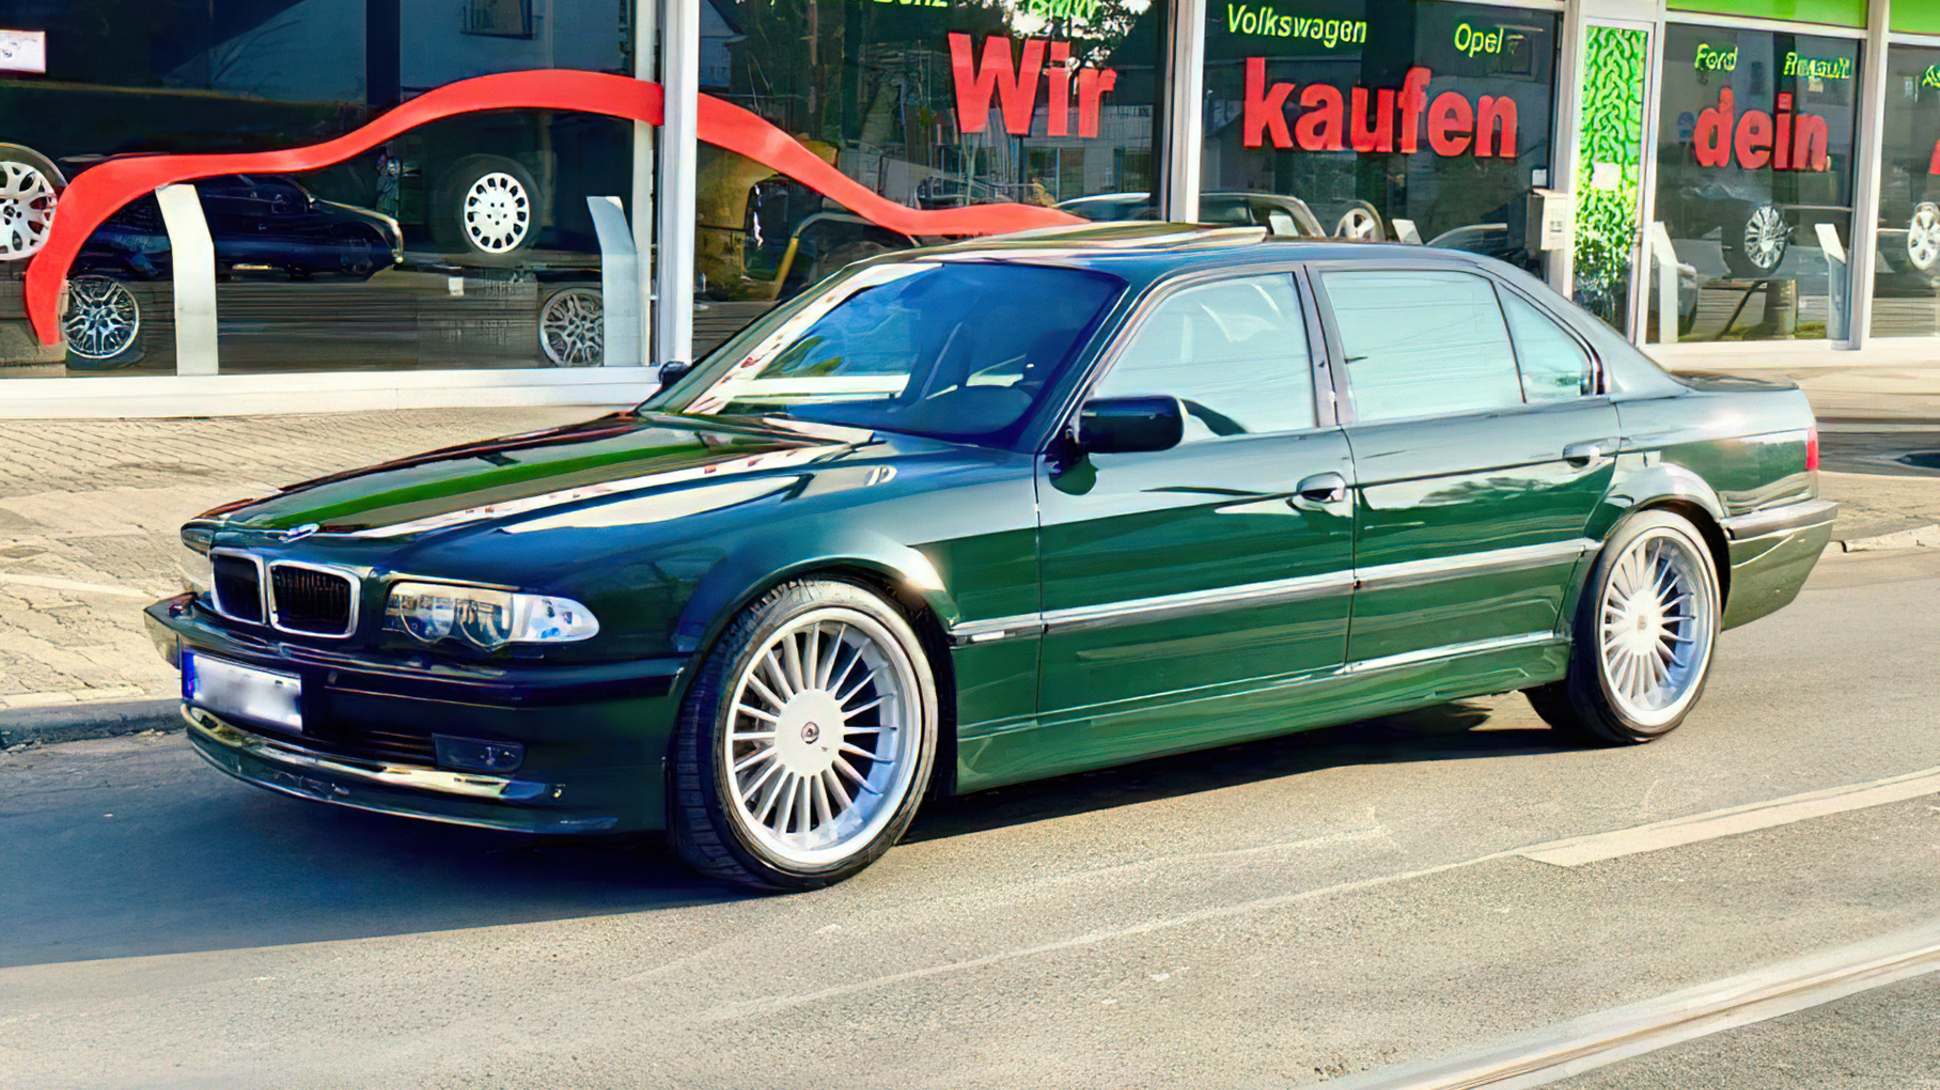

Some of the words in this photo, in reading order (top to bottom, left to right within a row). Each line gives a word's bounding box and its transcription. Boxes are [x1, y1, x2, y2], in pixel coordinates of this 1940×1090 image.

[1228, 3, 1367, 48] Volkswagen
[1454, 23, 1504, 58] Opel
[1694, 43, 1738, 71] Ford
[948, 32, 1117, 138] Wir
[1243, 57, 1518, 158] kaufen
[1694, 85, 1829, 172] dein
